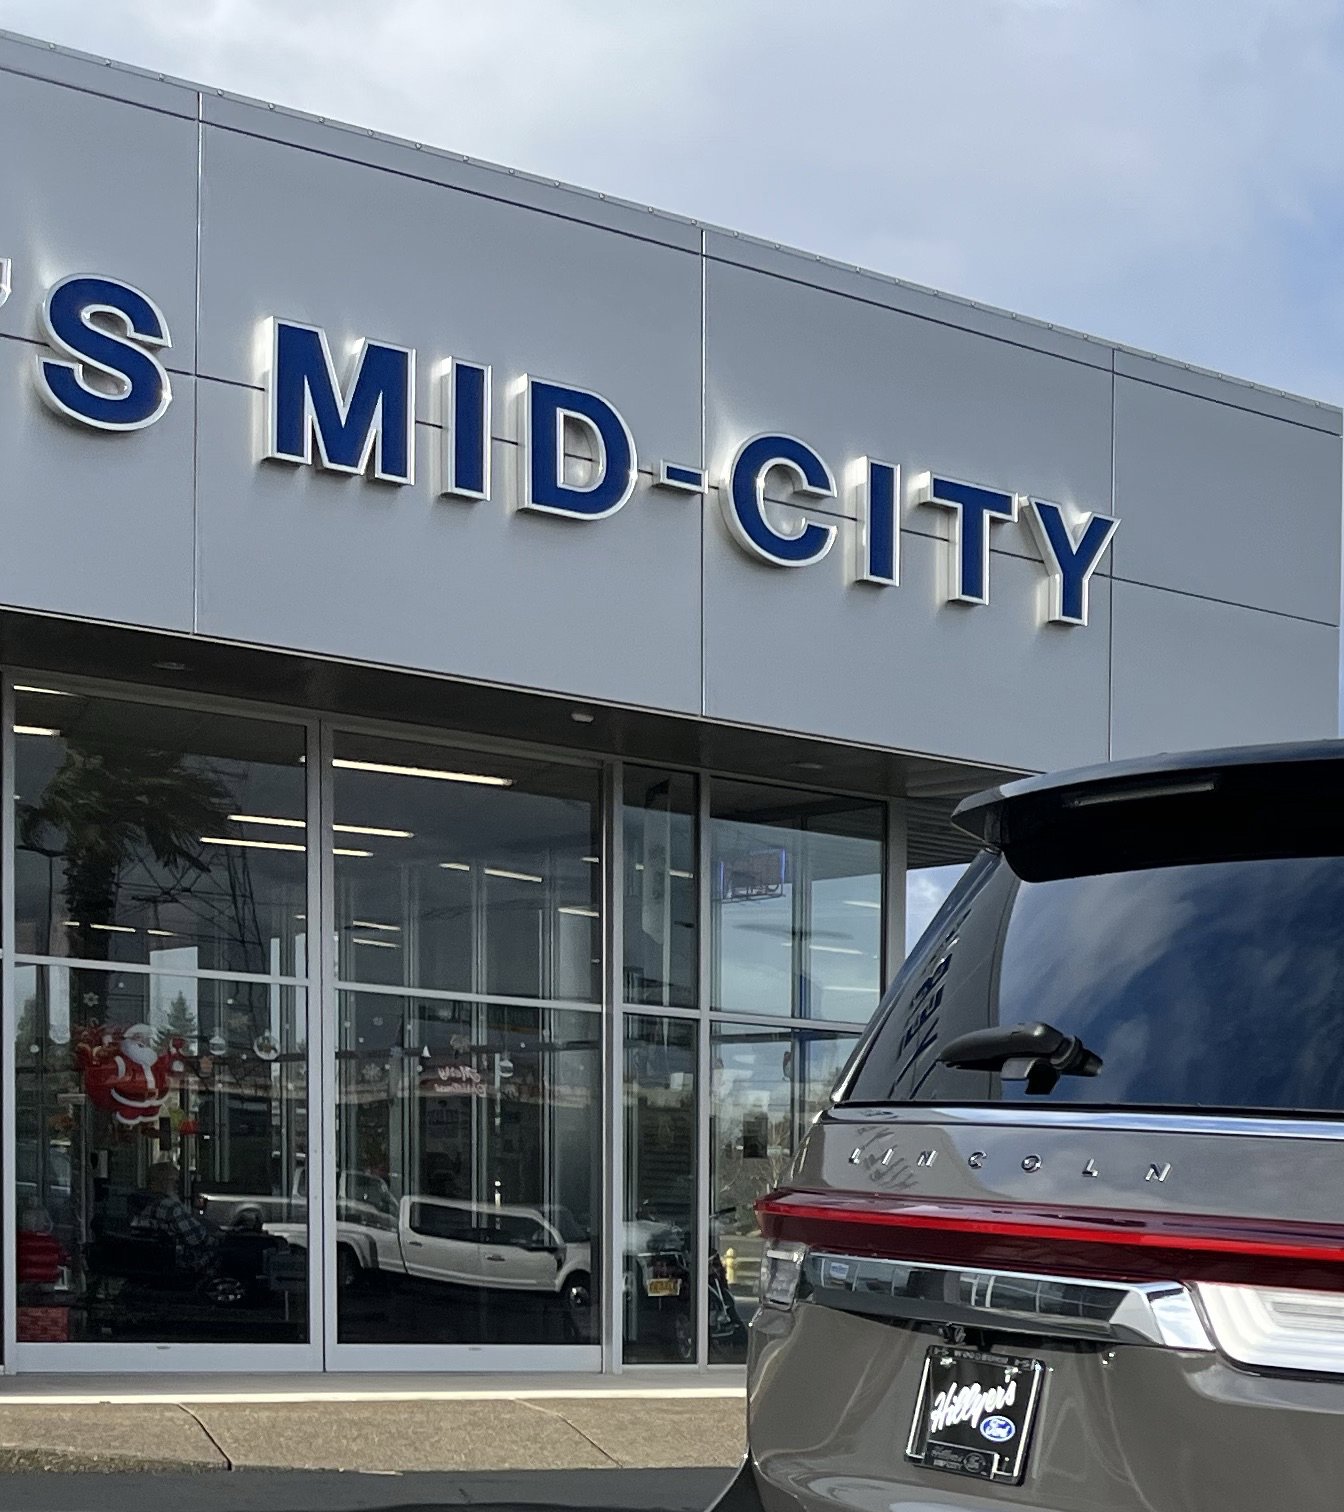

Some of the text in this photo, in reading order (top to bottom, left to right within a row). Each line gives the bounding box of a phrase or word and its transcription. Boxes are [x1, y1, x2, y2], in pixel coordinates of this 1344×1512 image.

[0, 258, 1122, 627] S MID-CITY
[848, 1147, 1172, 1183] LINCOLN
